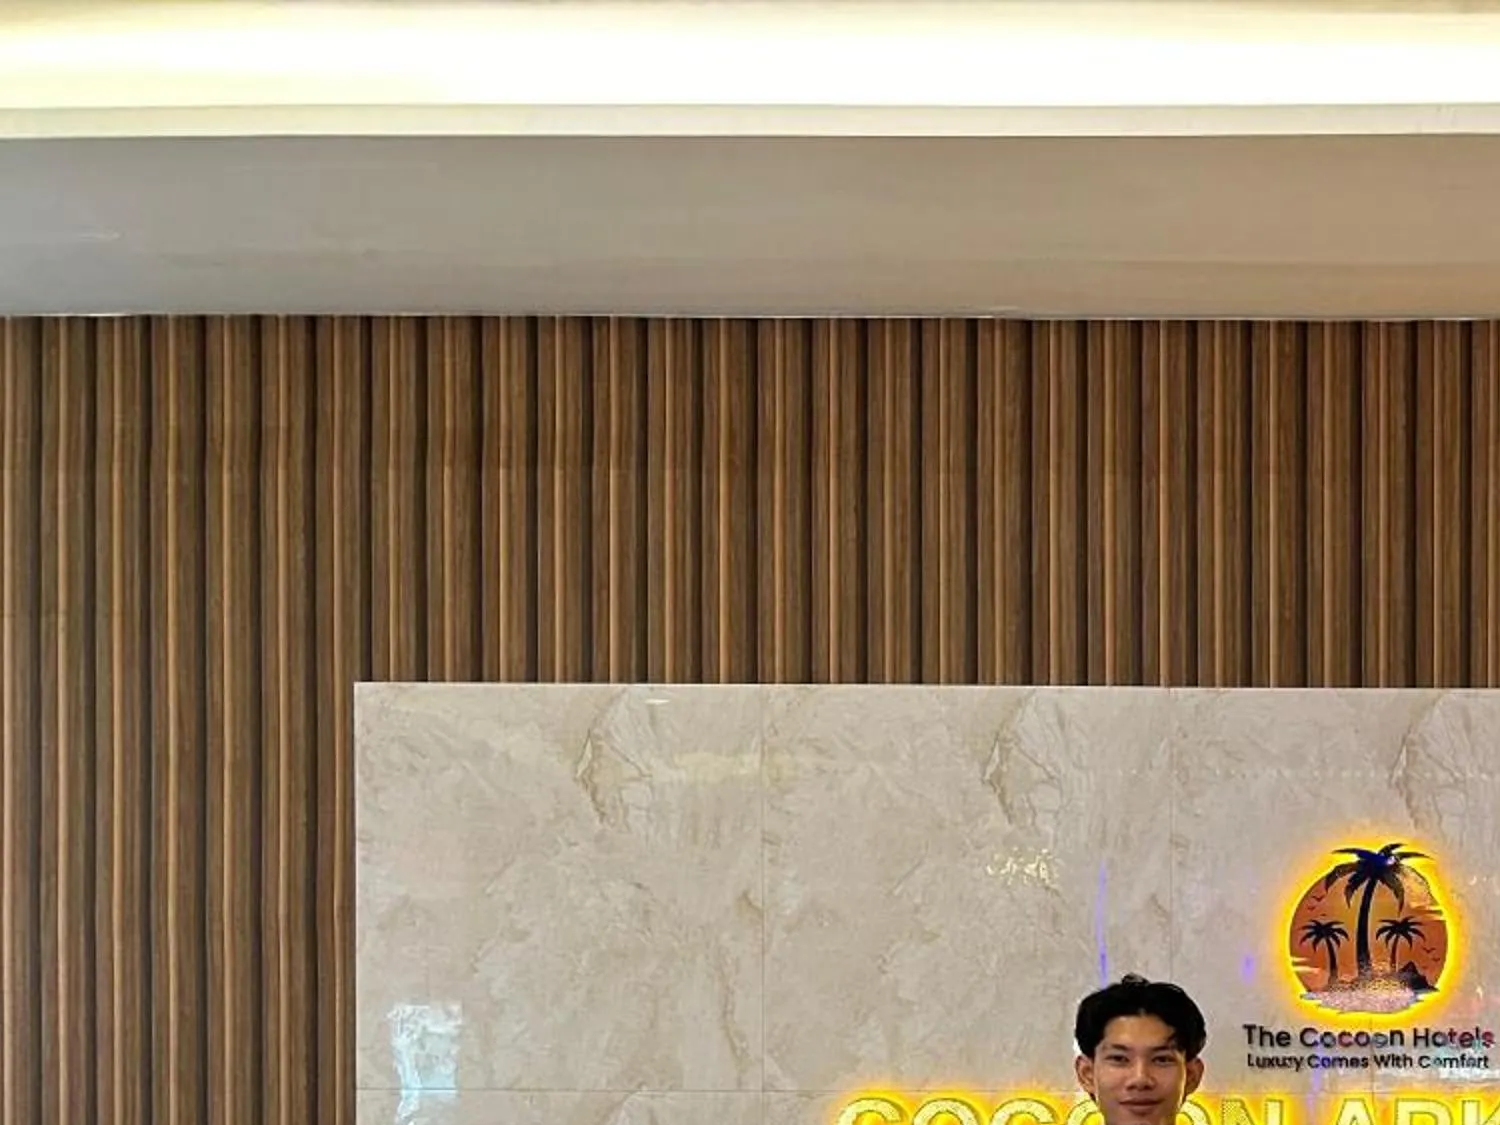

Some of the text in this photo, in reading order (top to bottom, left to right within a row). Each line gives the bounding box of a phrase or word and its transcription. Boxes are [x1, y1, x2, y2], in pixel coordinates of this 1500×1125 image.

[1242, 1024, 1497, 1049] The Cocoon Hotels
[1247, 1053, 1490, 1072] Luxury Comes With Comfort
